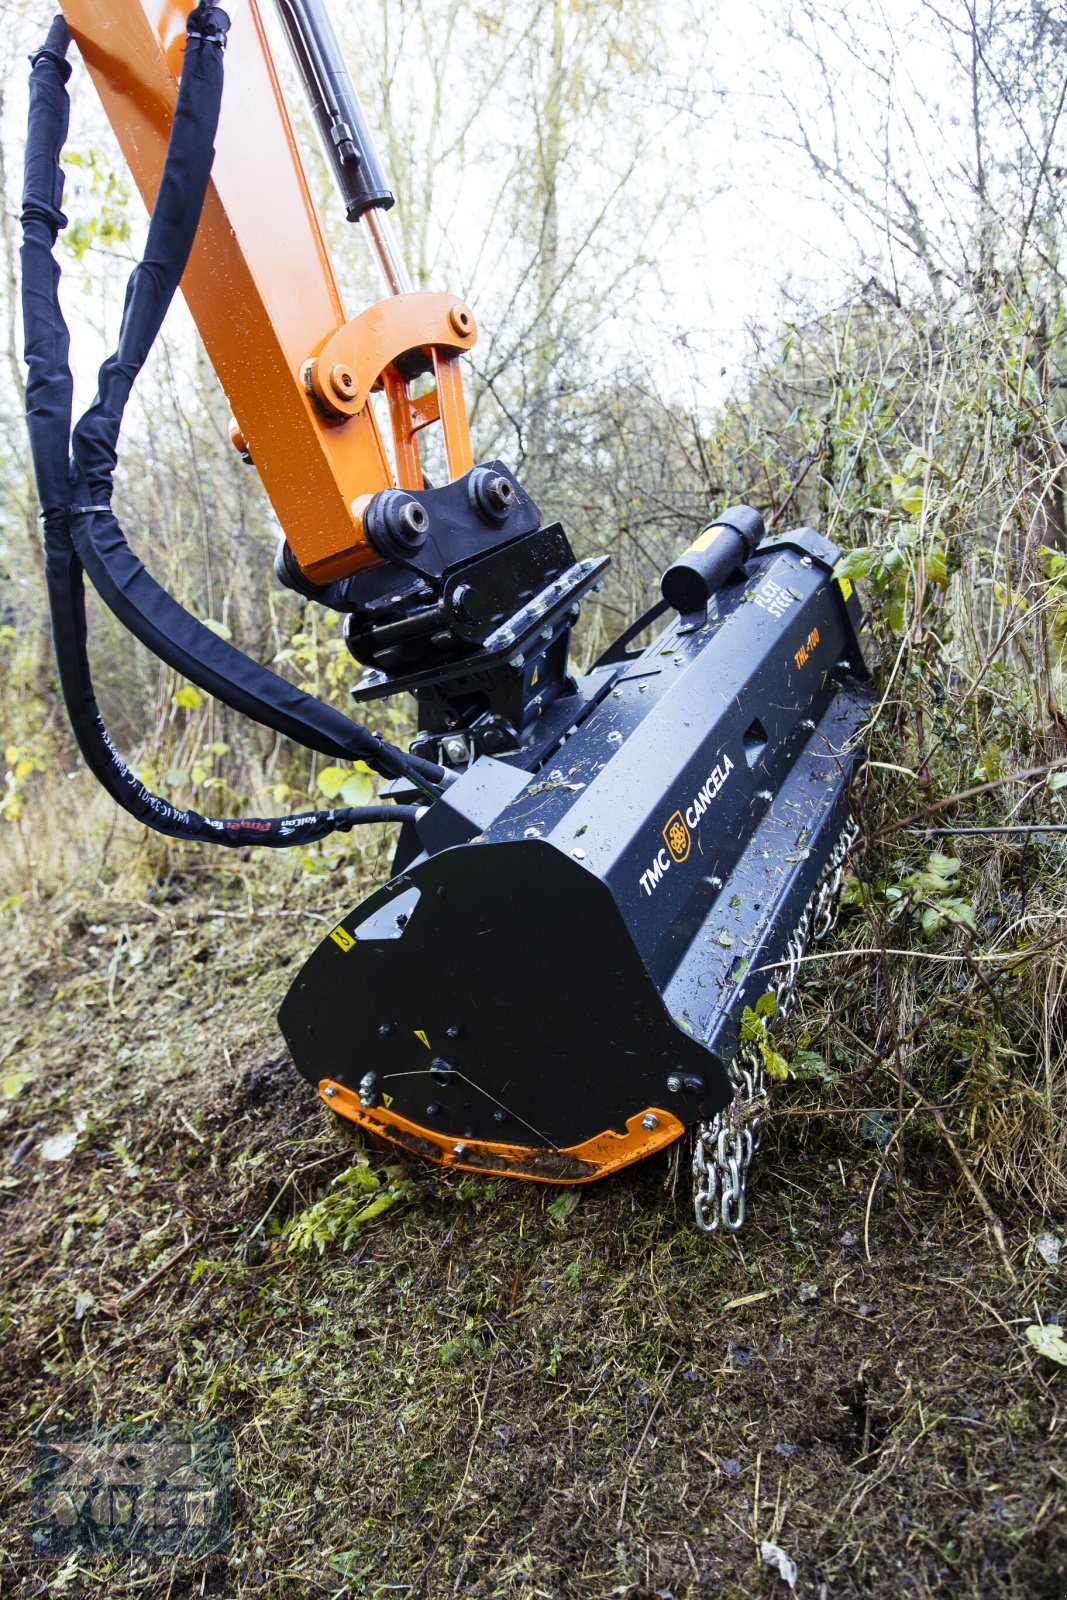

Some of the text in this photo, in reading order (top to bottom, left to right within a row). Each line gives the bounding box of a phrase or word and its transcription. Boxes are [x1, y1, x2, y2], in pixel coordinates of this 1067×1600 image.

[753, 580, 781, 608] FLEXI
[639, 754, 734, 896] TMC CANCELA
